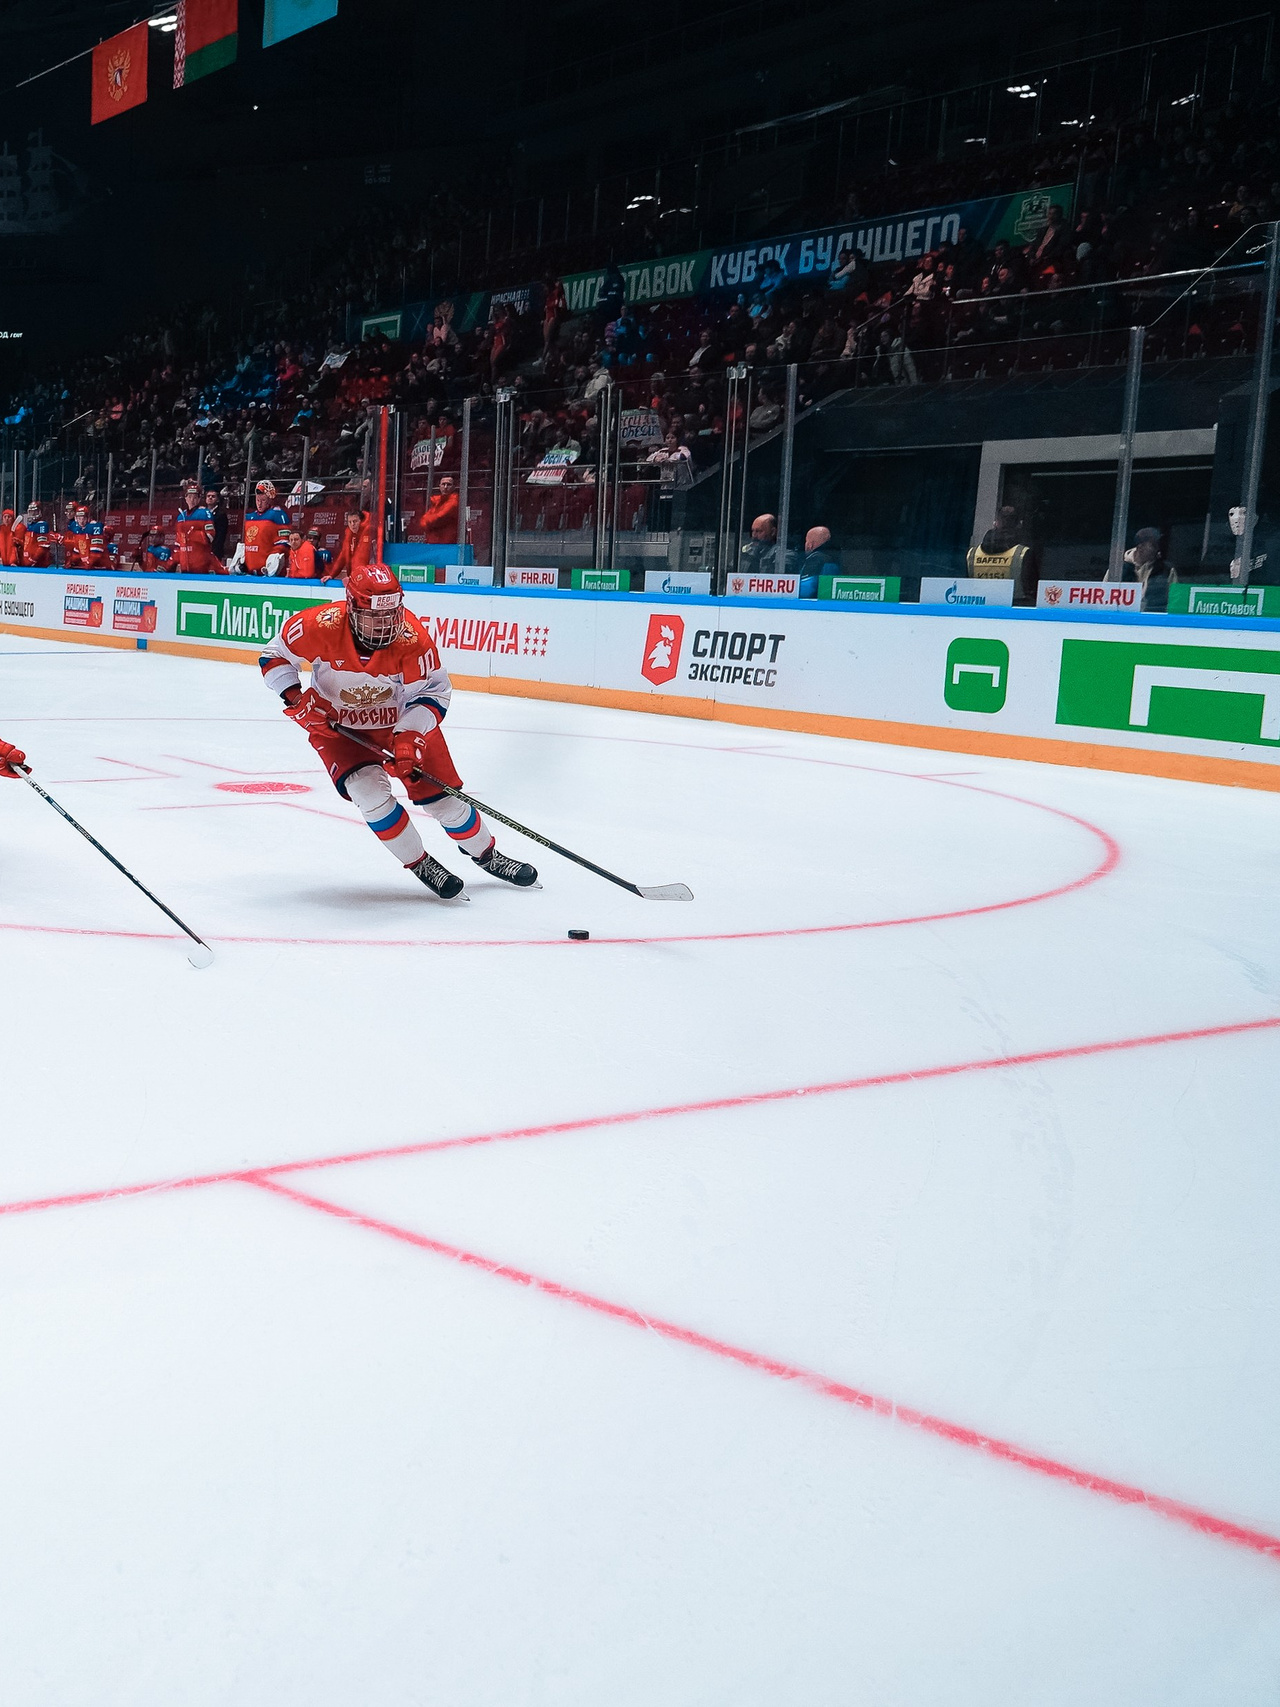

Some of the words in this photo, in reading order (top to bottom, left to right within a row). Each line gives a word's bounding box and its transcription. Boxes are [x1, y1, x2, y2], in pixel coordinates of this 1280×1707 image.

[623, 260, 696, 301] ТАВОК
[520, 572, 554, 584] FHR.RU
[748, 578, 796, 594] FHR.RU
[66, 584, 88, 595] КРАСНАЯ
[116, 586, 140, 598] КРАСНАЯ
[836, 588, 853, 600] ЛИГА
[854, 590, 880, 601] СТАВОК
[1069, 587, 1136, 606] FHR.RU
[4, 600, 34, 618] БУДУЩЕГО
[66, 596, 88, 611] МАШИНА
[115, 600, 140, 616] МАШИНА
[1195, 600, 1219, 614] ЛИГА
[1220, 602, 1257, 616] СТАВОК
[220, 598, 259, 638] ЛИГА
[261, 601, 299, 639] СТ
[287, 618, 304, 645] 10
[436, 617, 519, 655] МАШИНА
[692, 629, 786, 664] СПОРТ
[418, 648, 436, 679] 10
[688, 663, 778, 688] ЭКСПРЕСС
[338, 706, 398, 726] РОССИЯ
